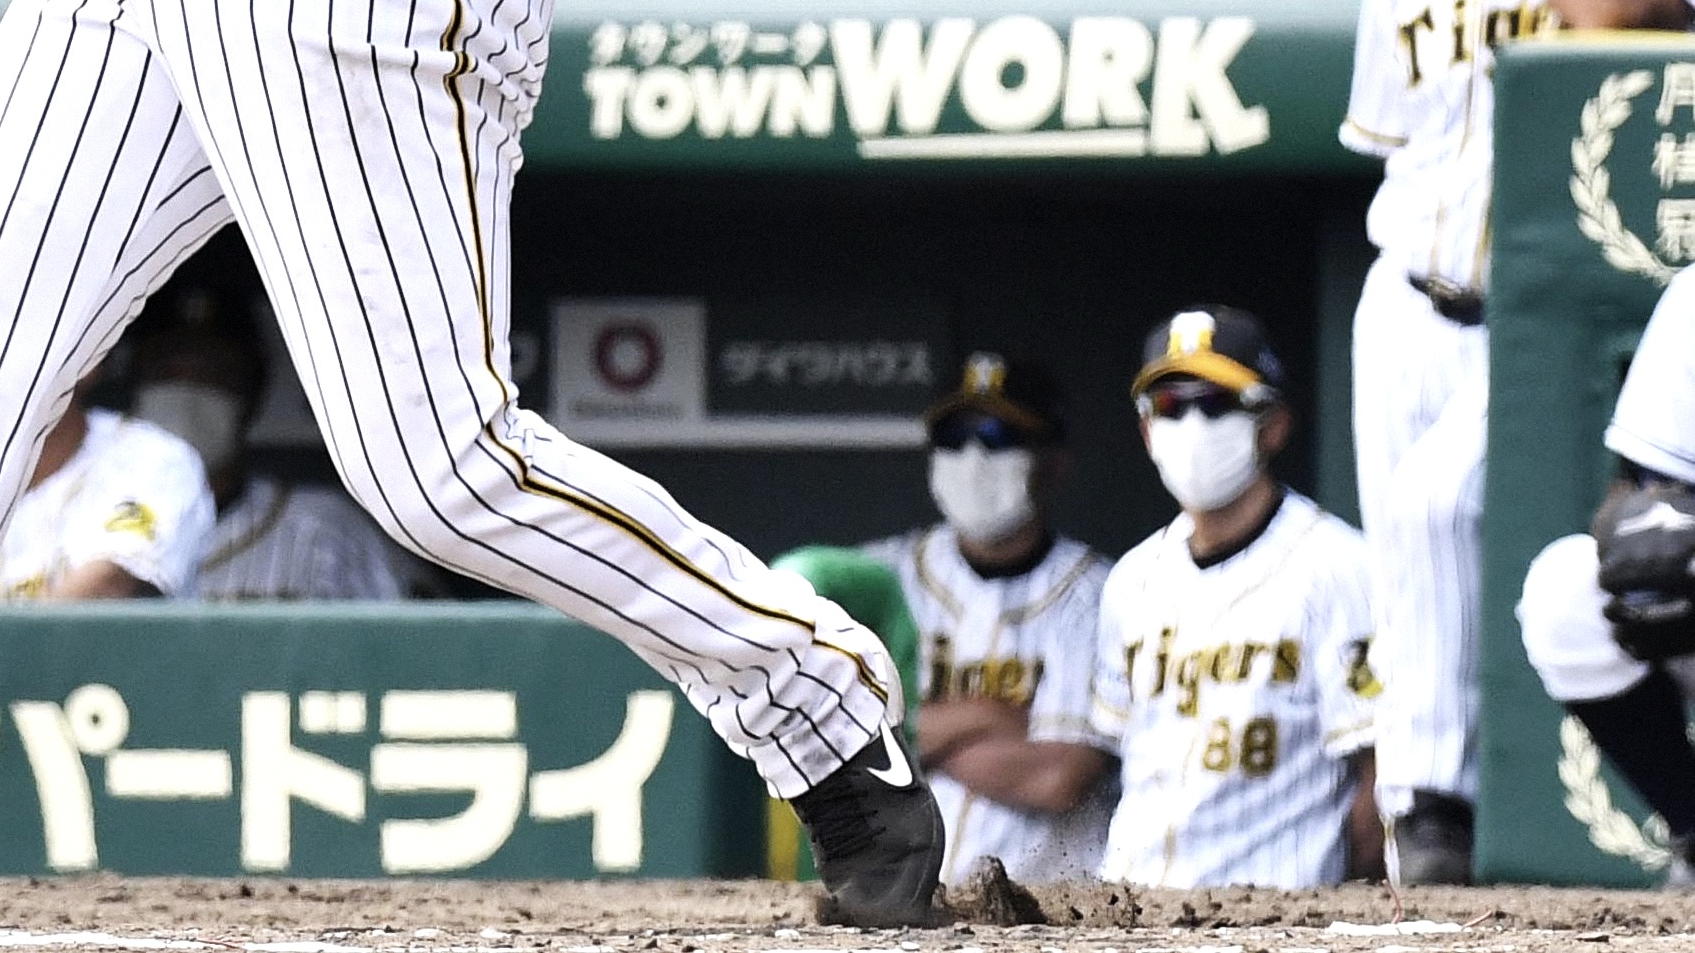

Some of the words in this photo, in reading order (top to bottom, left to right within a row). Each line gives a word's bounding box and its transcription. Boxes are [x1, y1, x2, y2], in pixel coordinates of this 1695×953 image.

[589, 20, 827, 67] タウンワーク
[1203, 715, 1278, 777] 88
